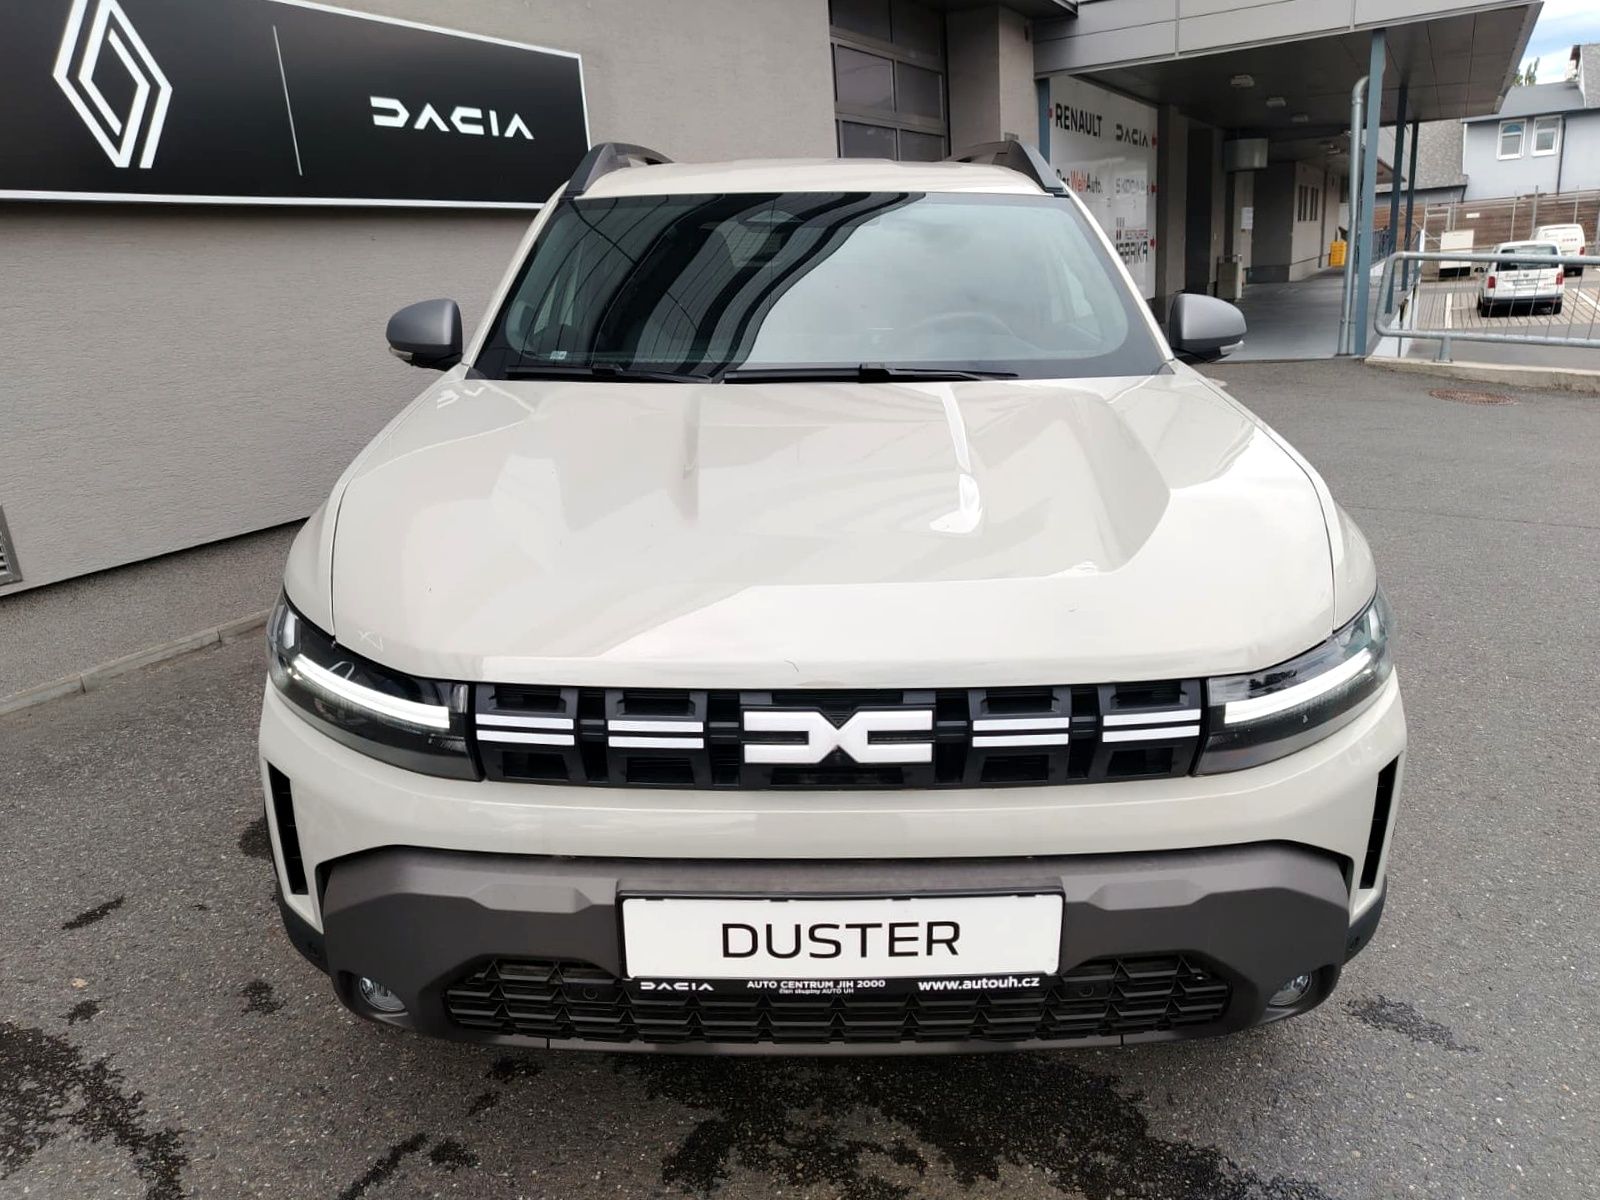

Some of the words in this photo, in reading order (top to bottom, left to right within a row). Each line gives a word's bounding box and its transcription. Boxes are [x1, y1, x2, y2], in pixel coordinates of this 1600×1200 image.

[370, 96, 535, 140] DACIA
[1055, 102, 1102, 137] RENAULT
[1115, 123, 1148, 147] DACIA
[722, 921, 961, 959] DUSTER
[640, 982, 714, 991] DACIA
[747, 981, 777, 989] AUTO
[780, 981, 834, 989] CENTRUM
[836, 981, 854, 989] JIH
[857, 980, 886, 988] 2000
[918, 976, 1040, 991] www.autouh.cz
